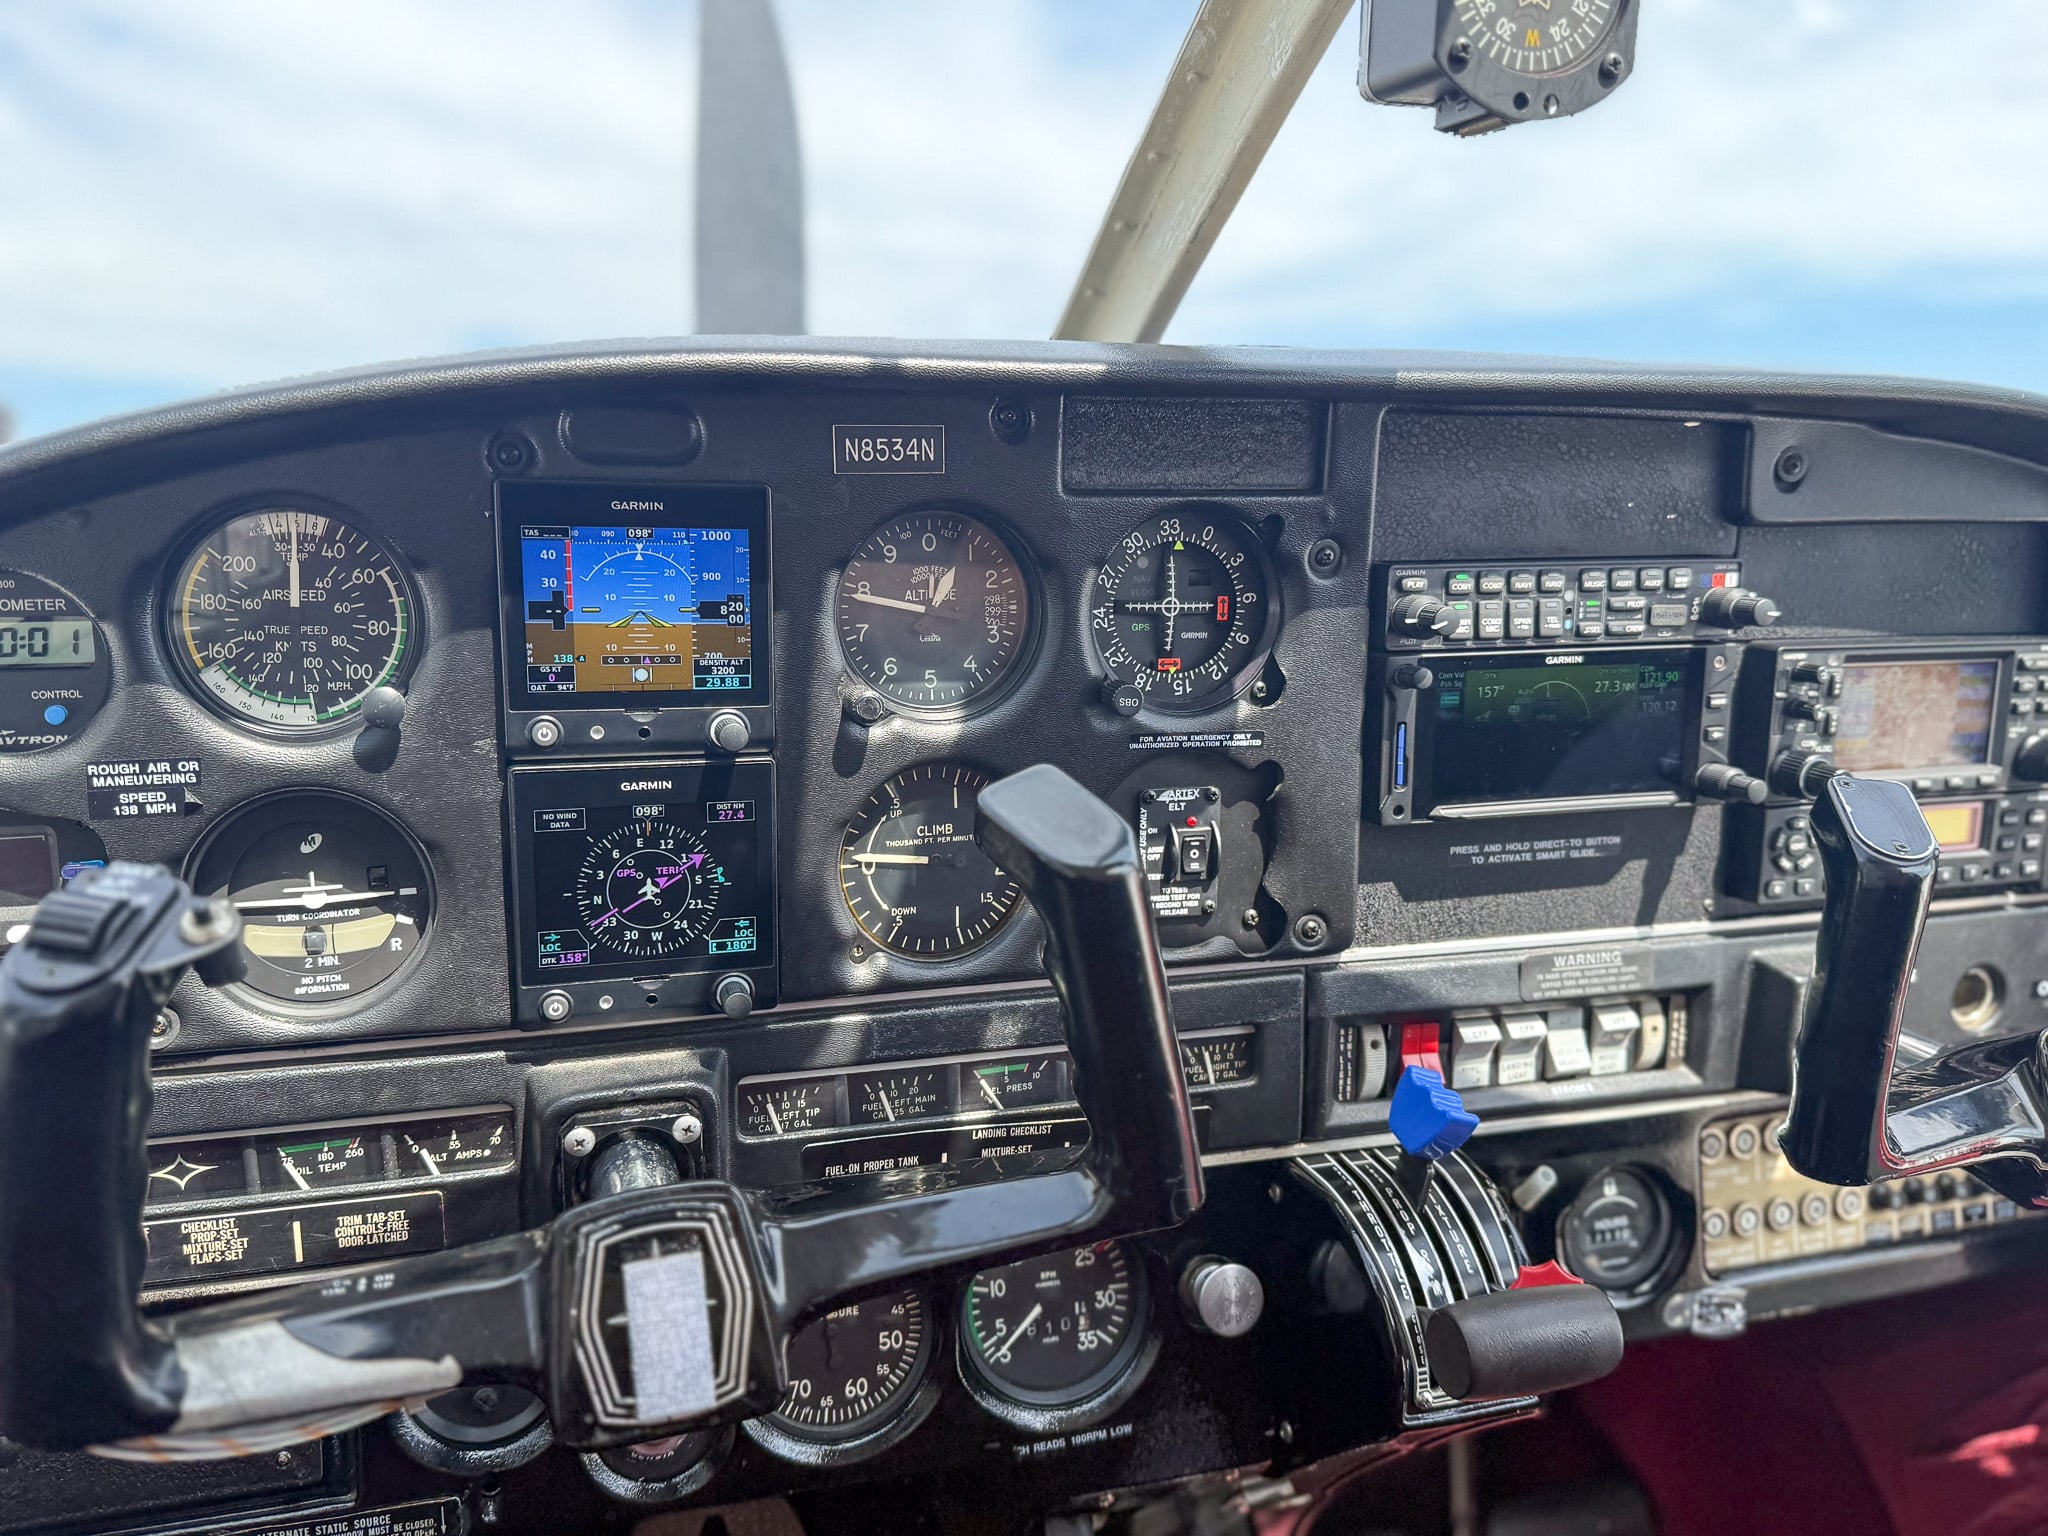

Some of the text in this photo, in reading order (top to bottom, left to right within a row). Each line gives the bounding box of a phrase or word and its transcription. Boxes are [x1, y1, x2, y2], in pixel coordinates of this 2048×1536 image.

[845, 438, 935, 462] N8534N
[611, 501, 664, 511] GARMIN
[523, 529, 539, 537] TAS
[1160, 518, 1180, 535] 33
[672, 531, 686, 539] 110
[701, 531, 731, 541] 1000
[922, 533, 937, 552] 0
[321, 543, 345, 559] 40
[540, 550, 556, 560] 40
[883, 545, 897, 564] 9
[222, 555, 256, 572] 200
[352, 568, 375, 584] 60
[702, 572, 721, 581] 900
[985, 570, 999, 588] 2
[541, 578, 557, 588] 30
[262, 589, 327, 601] AIRSEED
[200, 594, 227, 610] 180
[241, 598, 262, 610] 160
[263, 625, 291, 635] TRUE
[368, 620, 390, 636] 80
[855, 623, 869, 642] 7
[1131, 623, 1150, 632] GPS
[244, 630, 264, 641] 140
[1180, 632, 1208, 640] GARMIN
[208, 642, 237, 659] 160
[263, 652, 282, 664] 120
[303, 657, 323, 668] 100
[553, 654, 574, 663] 138
[699, 658, 745, 667] DENSITY ALT
[963, 654, 978, 672] 4
[1545, 655, 1583, 665] GARMIN
[346, 664, 373, 680] 100
[711, 666, 735, 675] 3200
[884, 657, 898, 676] 6
[705, 677, 740, 687] 29.88
[924, 669, 937, 688] 5
[31, 690, 83, 700] CONTROL
[1222, 739, 1262, 747] PROHIBITED
[1232, 733, 1252, 741] ONLY
[87, 761, 200, 776] ROUGH AIR OR
[92, 773, 197, 788] MANEUVERING
[620, 780, 673, 791] GARMIN
[119, 791, 167, 804] SPEED
[1168, 788, 1200, 799] ARTEX
[113, 802, 177, 816] 138 MPH
[1168, 802, 1187, 811] ELT
[542, 812, 578, 821] NO WIND
[718, 810, 745, 820] 27.4
[890, 810, 902, 818] UP
[550, 821, 570, 829] DATA
[916, 824, 953, 837] CLIMB
[885, 838, 923, 848] THOUSAND
[1450, 835, 1621, 855] PRESS AND HOLD DIRECT-TO BUTTON
[1471, 850, 1566, 864] TO ACTIVATE SMART
[616, 869, 636, 877] GPS
[276, 908, 361, 923] TURN COORDINATOR
[891, 906, 917, 916] DOWN
[734, 928, 754, 937] LOC
[391, 937, 403, 952] R
[541, 943, 561, 951] LOC
[304, 958, 314, 969] 2
[541, 957, 557, 965] DTK
[1553, 951, 1622, 968] WARNING
[301, 974, 342, 985] NO PITCH
[295, 983, 350, 995] INFORMATION
[1006, 1082, 1033, 1093] PRESS
[862, 1094, 936, 1112] FUEL LEFT MAIN
[908, 1105, 926, 1114] GAL
[748, 1107, 821, 1125] FUEL LEFT TIP
[793, 1118, 812, 1128] GAL
[972, 1125, 1053, 1141] LANDING CHECKLIST
[318, 1152, 334, 1162] 180
[345, 1147, 364, 1158] 260
[455, 1149, 483, 1160] AMPS
[981, 1144, 1033, 1158] MIXTURE-SET
[318, 1161, 347, 1173] TEMP
[863, 1159, 895, 1172] PROPER
[897, 1155, 920, 1167] TANK
[1385, 1186, 1416, 1236] PROP
[336, 1209, 406, 1227] TRIM TAB-SET
[181, 1217, 236, 1234] CHECKLIST
[334, 1219, 410, 1238] CONTROLS-FREE
[190, 1227, 239, 1243] PROP-SET
[338, 1230, 409, 1248] DOOR-LATCHED
[182, 1237, 249, 1255] MIXTURE-SET
[1351, 1189, 1410, 1300] THROTTLE
[190, 1248, 244, 1265] FLAPS-SET
[1075, 1248, 1095, 1268] 25
[990, 1278, 1006, 1298] 10
[1094, 1289, 1116, 1309] 30
[879, 1329, 903, 1351] 50
[1077, 1330, 1098, 1351] 35
[789, 1378, 812, 1399] 70
[844, 1377, 869, 1398] 60
[1033, 1423, 1133, 1454] READS 100RPM LOW
[353, 1514, 392, 1528] SOURCE
[368, 1525, 390, 1536] MUST
[393, 1522, 404, 1532] BE
